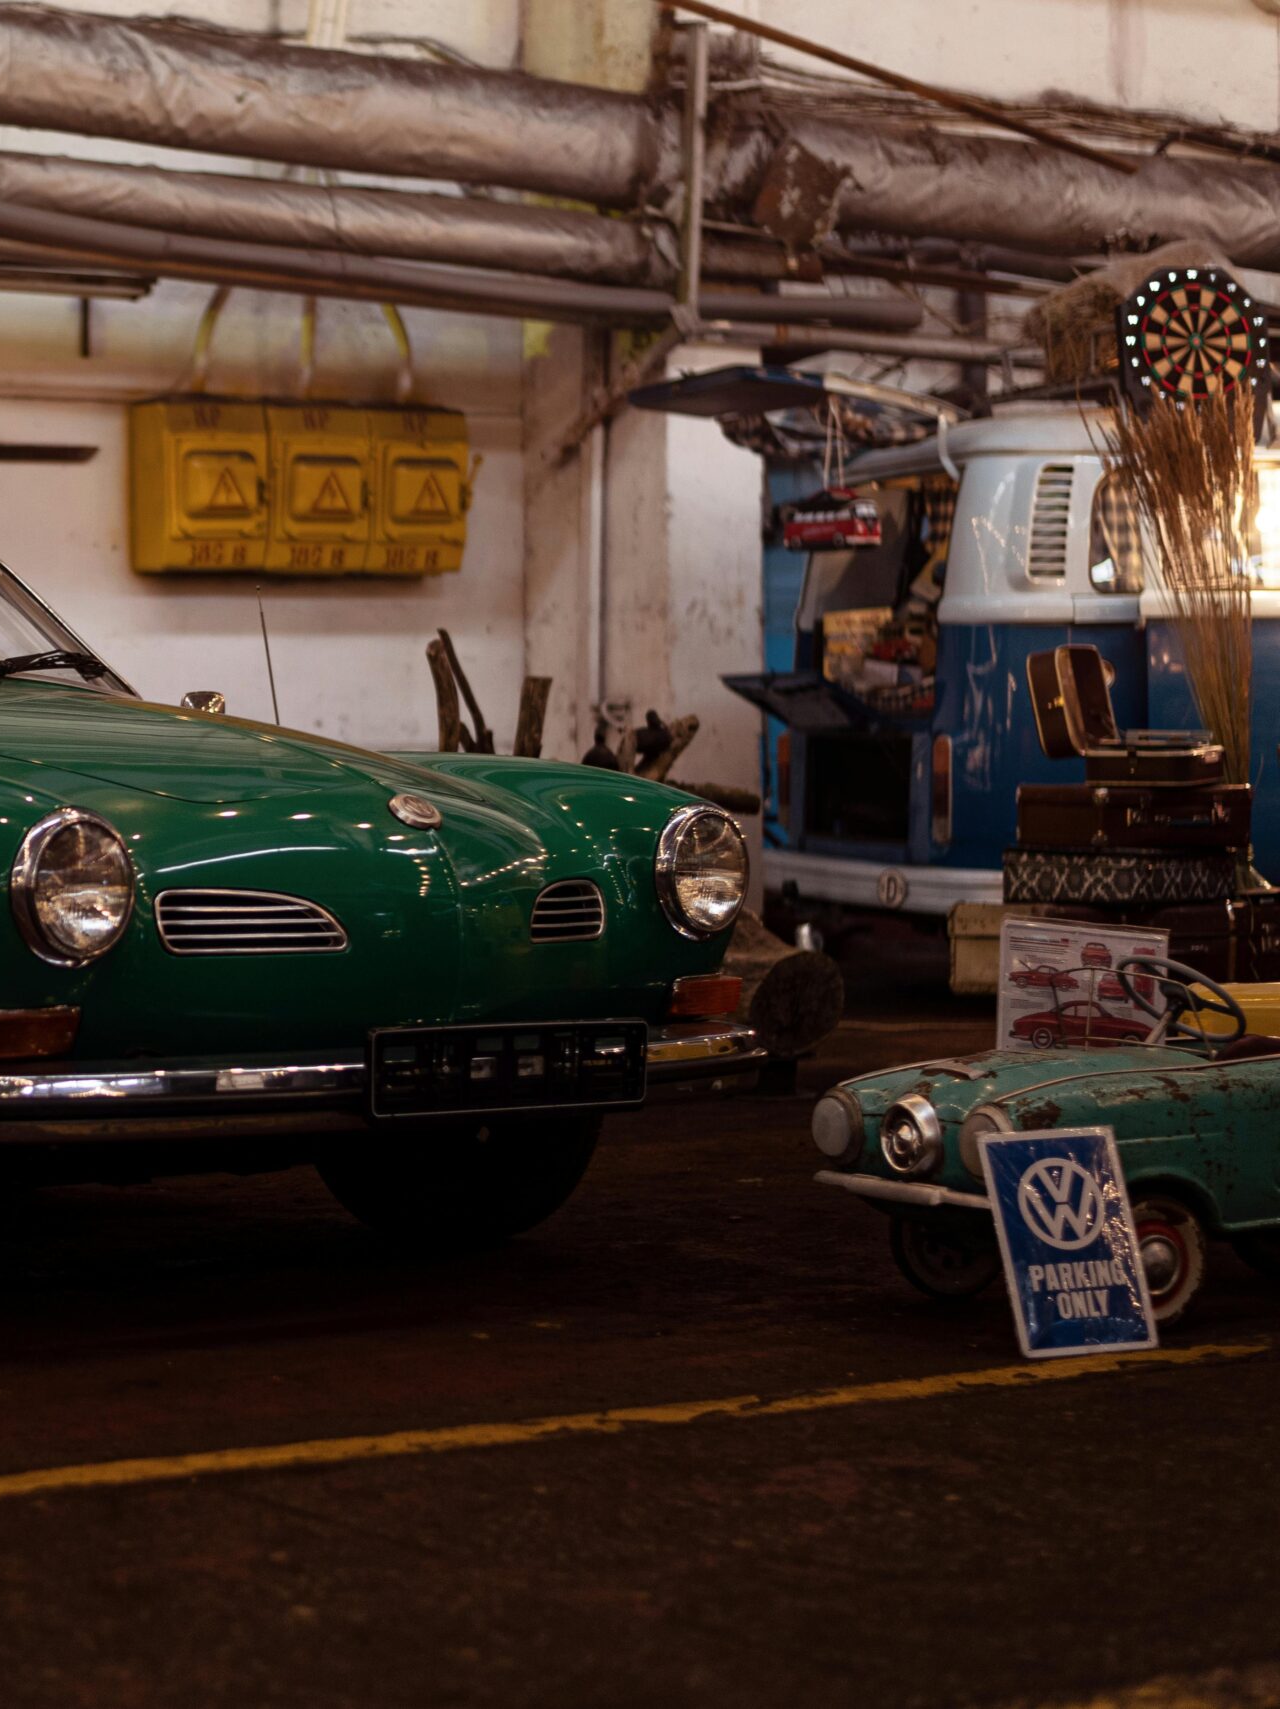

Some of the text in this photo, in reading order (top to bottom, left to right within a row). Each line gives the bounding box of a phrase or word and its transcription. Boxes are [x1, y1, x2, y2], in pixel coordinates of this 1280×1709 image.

[1018, 1158, 1104, 1249] VW
[1029, 1261, 1127, 1291] PARKING
[1056, 1291, 1109, 1319] ONLY
